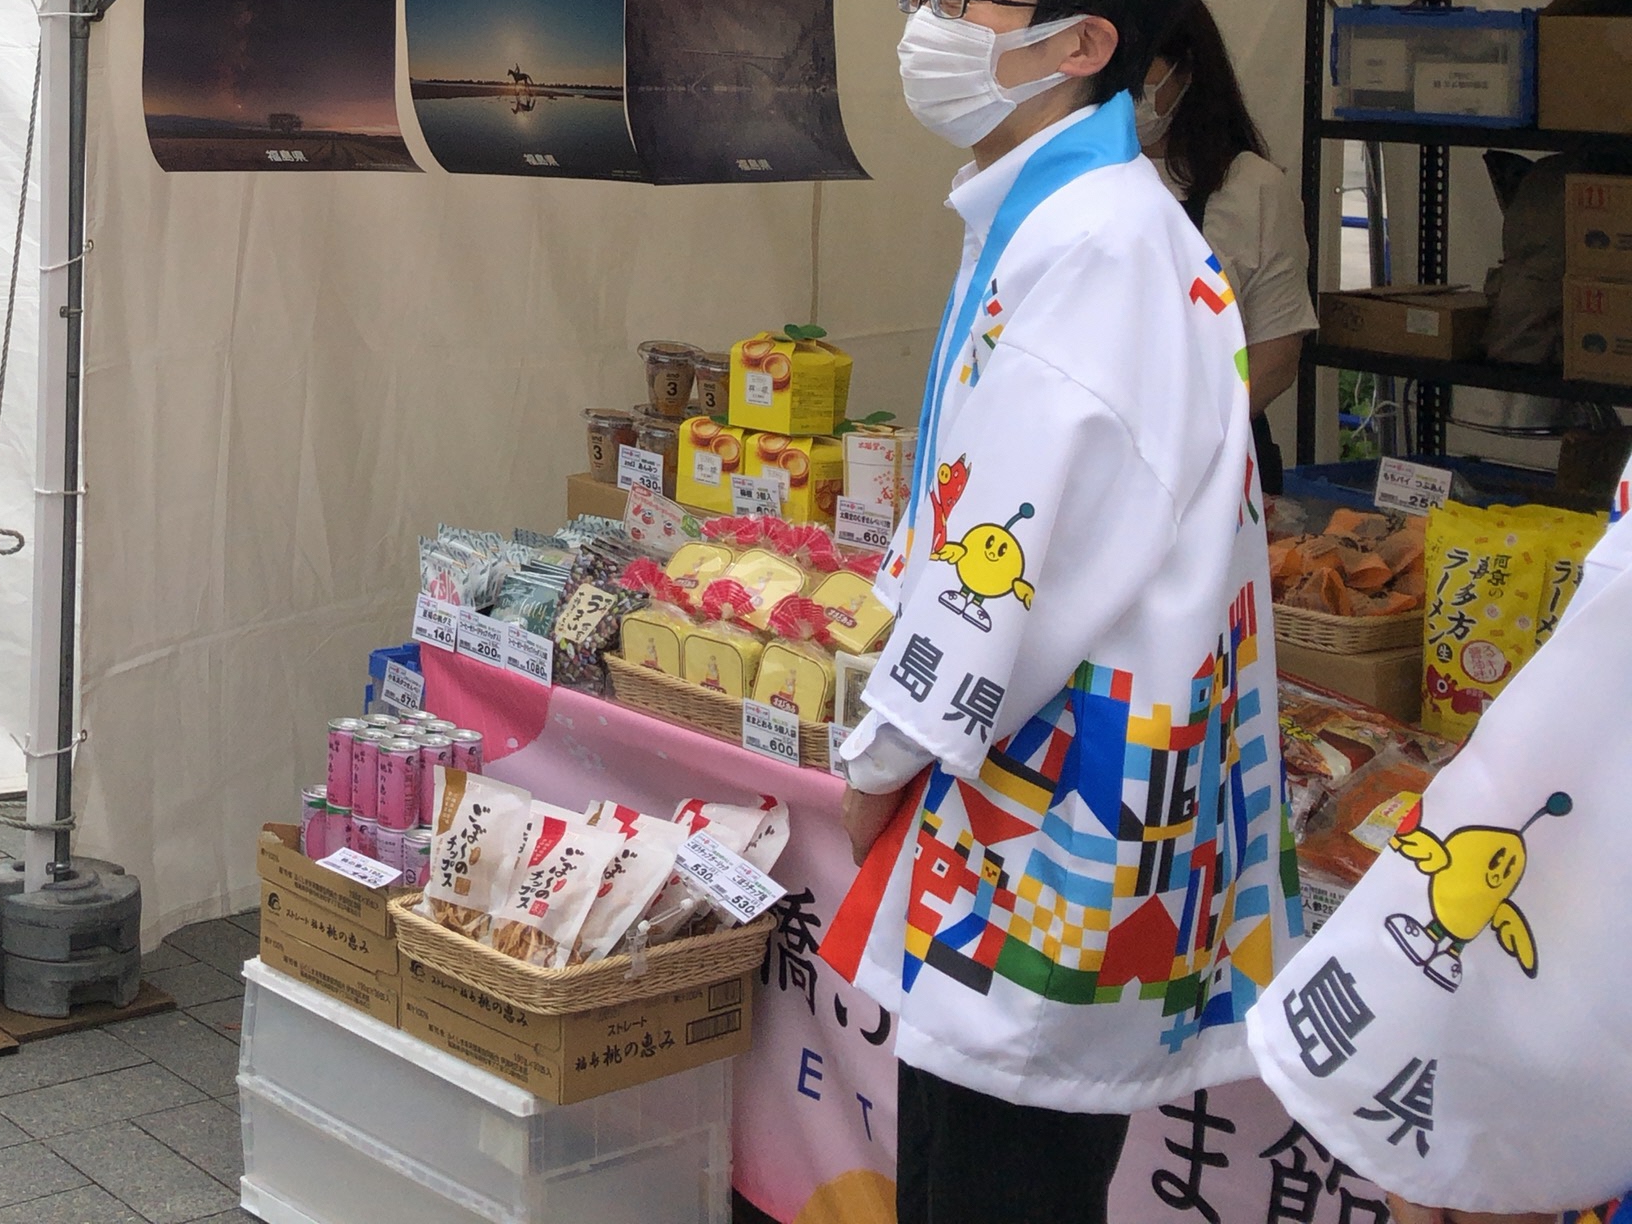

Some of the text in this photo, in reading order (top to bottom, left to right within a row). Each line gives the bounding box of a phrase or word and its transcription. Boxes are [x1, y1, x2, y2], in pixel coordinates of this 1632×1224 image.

[667, 382, 677, 396] 3
[706, 393, 716, 407] 3
[593, 445, 603, 460] 3
[1415, 481, 1445, 494] つぶあん
[1428, 548, 1470, 645] ラーメン
[1438, 645, 1451, 662] 生
[441, 835, 458, 888] チップス
[516, 870, 544, 909] チップス
[1303, 899, 1338, 915] 人参25
[286, 909, 310, 924] ストレート
[607, 1016, 648, 1037] ストレート
